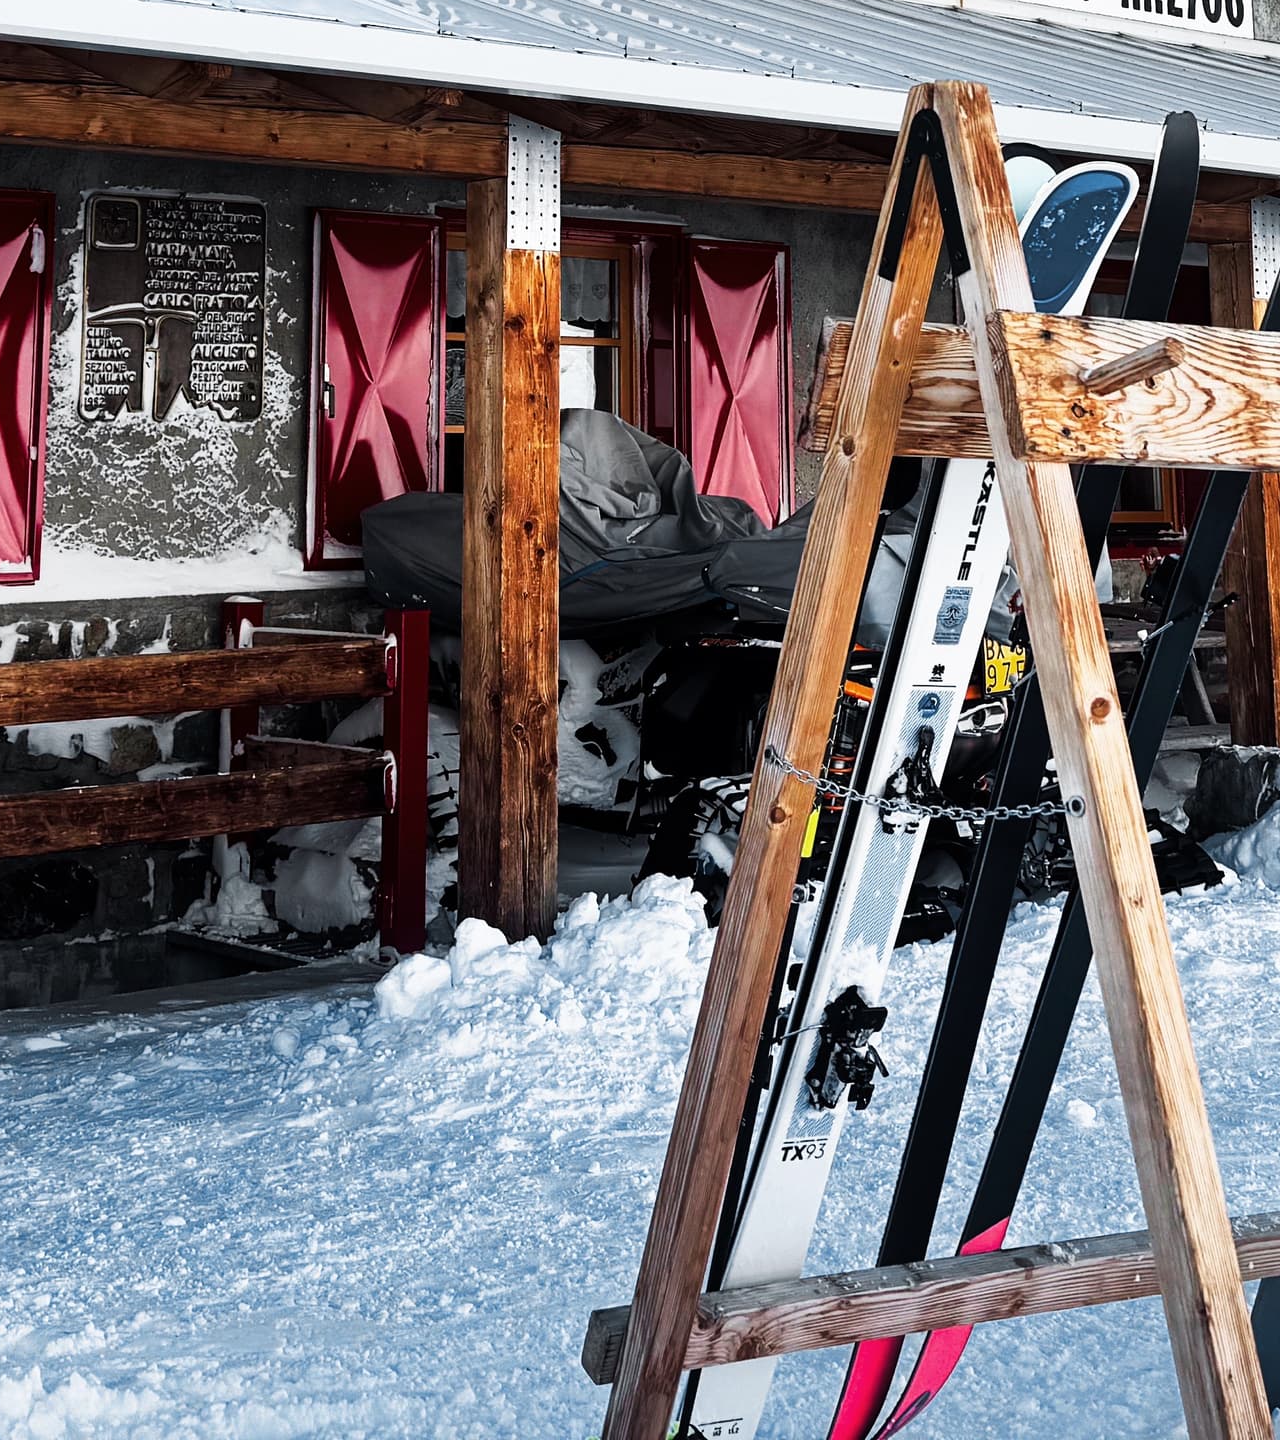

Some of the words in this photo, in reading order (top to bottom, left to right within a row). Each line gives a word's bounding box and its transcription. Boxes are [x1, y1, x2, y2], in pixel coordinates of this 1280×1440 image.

[191, 344, 257, 359] AUGUSTO
[85, 361, 128, 373] SEZIONE
[781, 1142, 827, 1162] TX93
